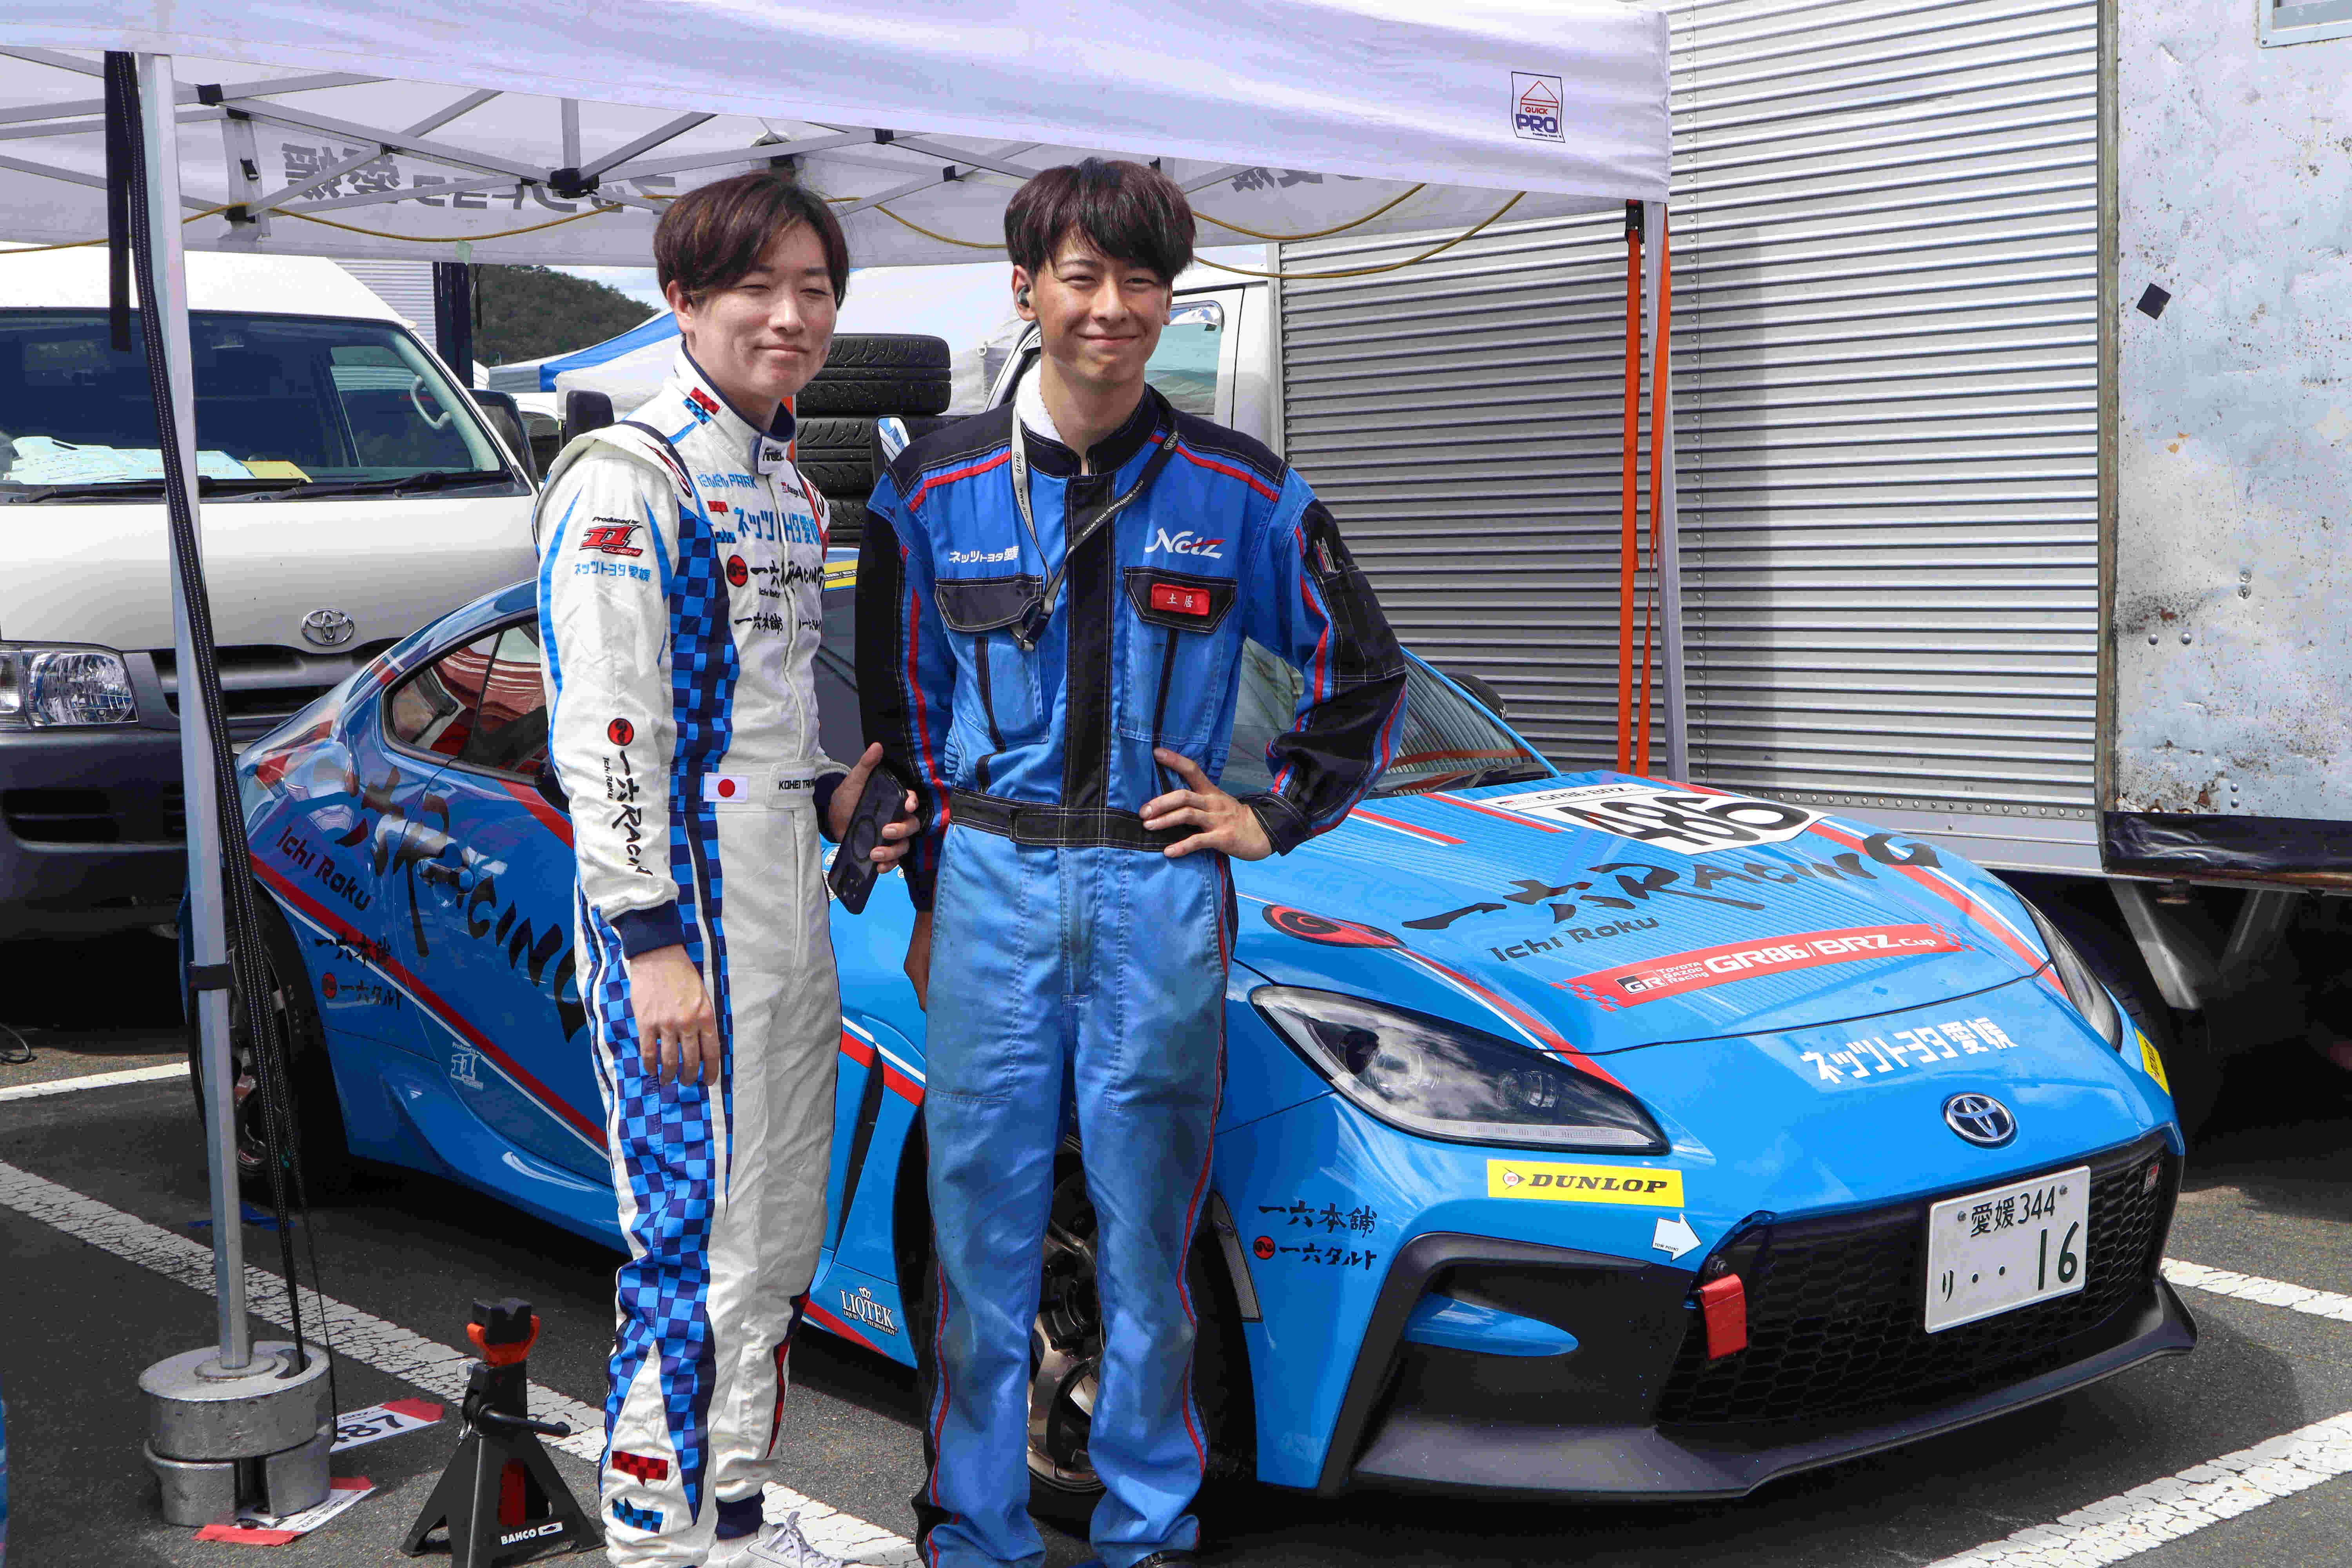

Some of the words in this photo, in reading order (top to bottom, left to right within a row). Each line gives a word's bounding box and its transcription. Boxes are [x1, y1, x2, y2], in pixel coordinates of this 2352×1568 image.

[1515, 114, 1558, 133] PRO
[1145, 528, 1226, 559] Netz
[605, 775, 613, 800] Roku
[779, 780, 800, 790] KOHEI
[1555, 796, 1810, 846] 486
[276, 825, 315, 870] Ichi
[314, 854, 372, 911] Roku
[1487, 935, 1564, 962] Ichi
[1563, 916, 1660, 944] Roku
[1704, 934, 1902, 973] GR86/BRZ
[1897, 938, 1938, 947] Cup
[1657, 962, 1702, 974] TOYOTA
[1662, 967, 1703, 979] GAZOO
[1667, 971, 1710, 984] Racing
[1624, 977, 1663, 993] GR
[1800, 1017, 2019, 1084] ネッツトヨタ愛媛
[1528, 1173, 1668, 1193] DUNLOP
[1258, 1200, 1377, 1238] 一六本舗
[1970, 1195, 2015, 1238] 愛媛
[2019, 1185, 2056, 1225] 344
[1279, 1242, 1377, 1270] 一六タルト
[2038, 1221, 2080, 1291] 16
[840, 1289, 895, 1330] LIQTEK
[844, 1310, 858, 1320] LIQUID
[867, 1319, 896, 1336] TECHNOLOGY
[501, 1529, 537, 1546] BAHCO
